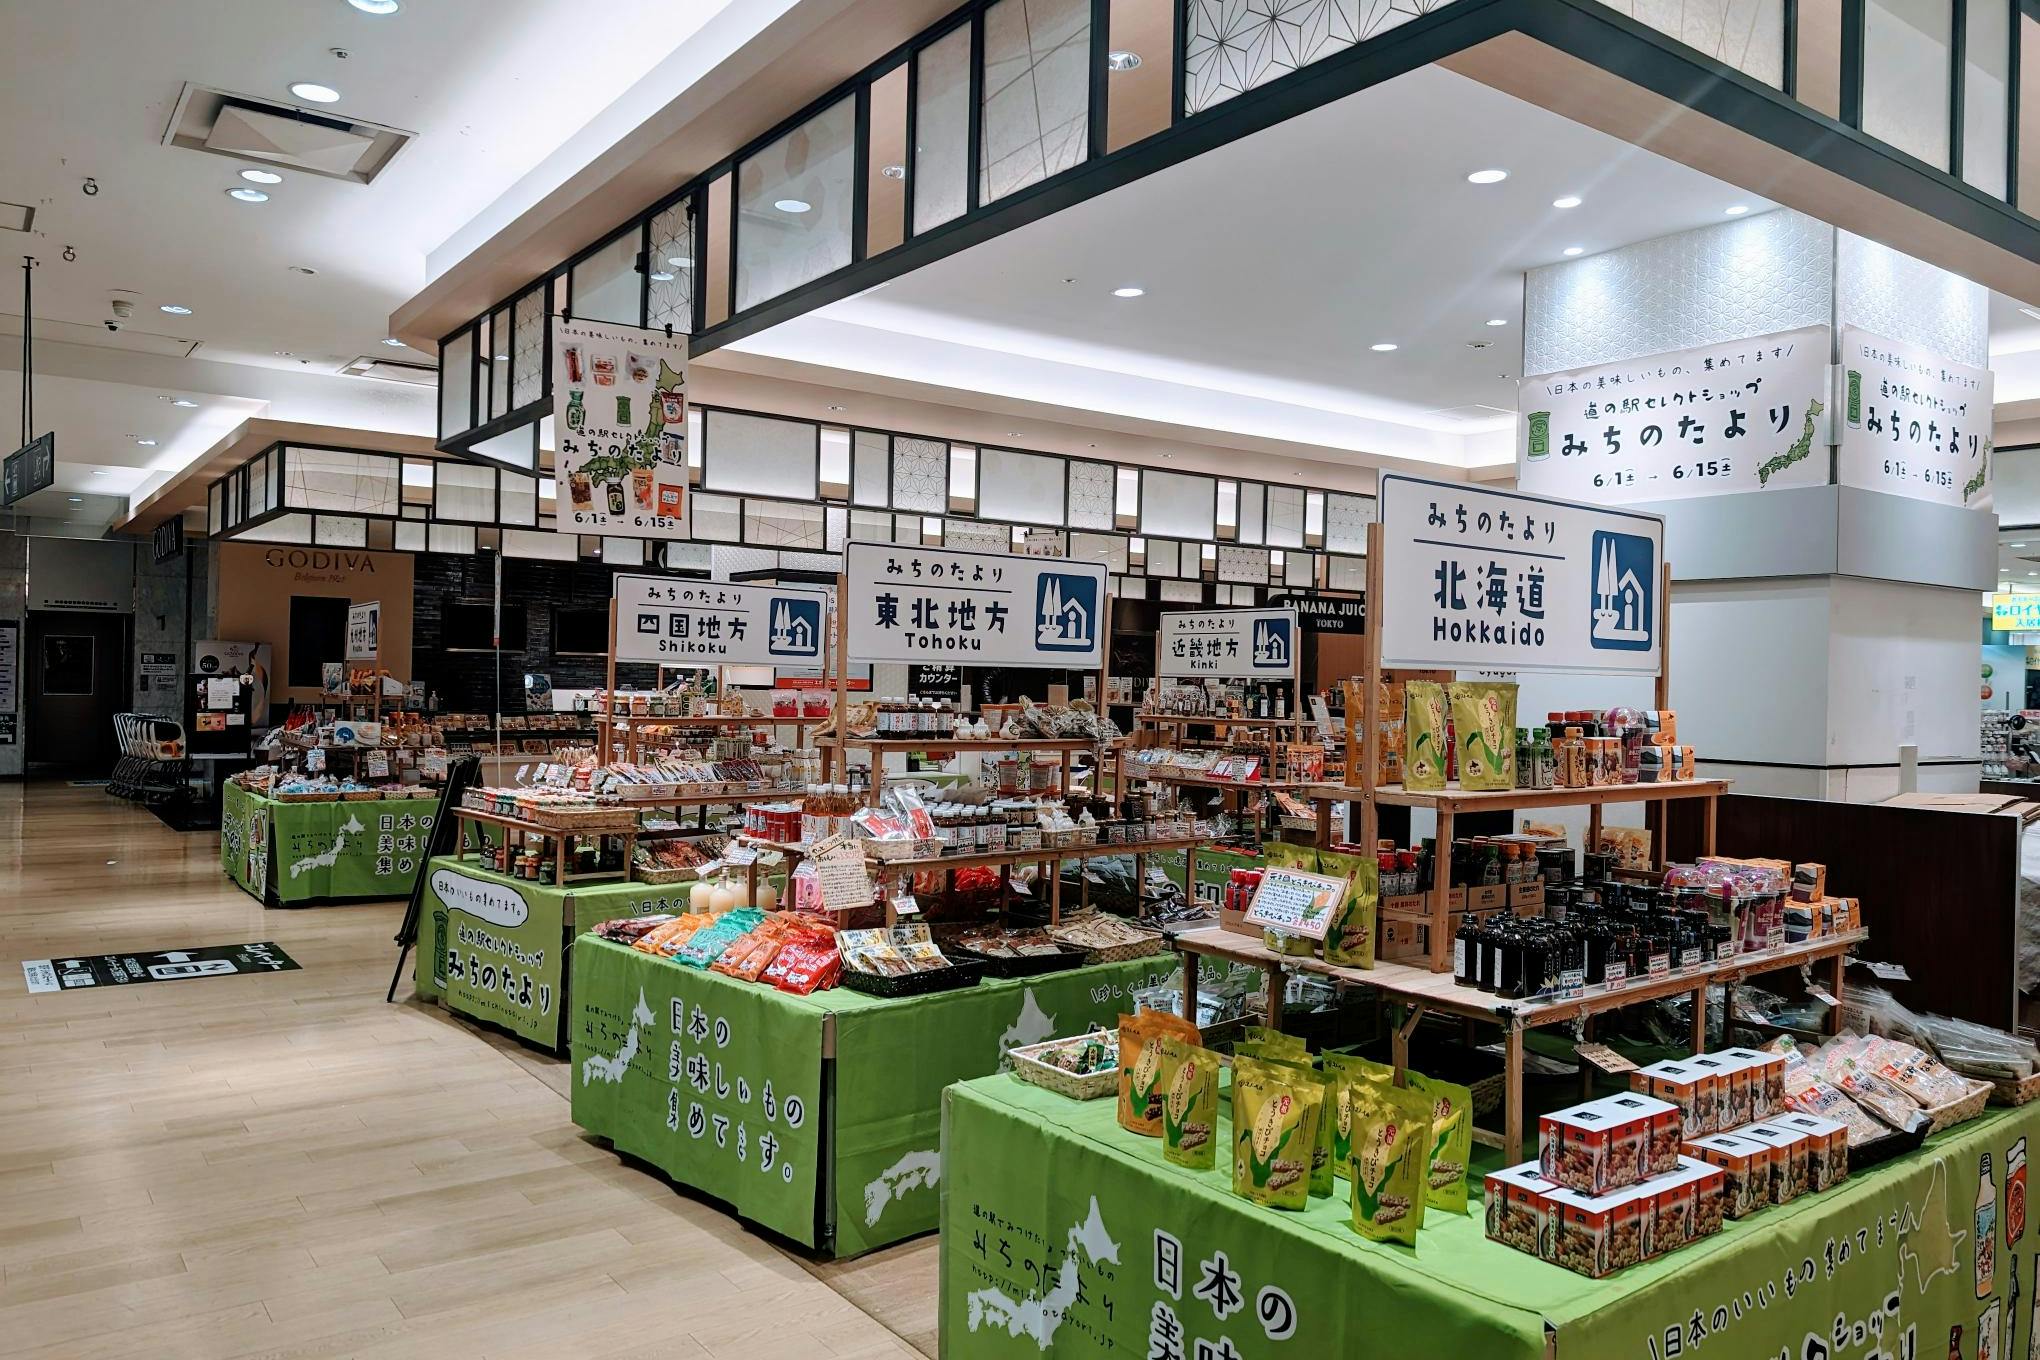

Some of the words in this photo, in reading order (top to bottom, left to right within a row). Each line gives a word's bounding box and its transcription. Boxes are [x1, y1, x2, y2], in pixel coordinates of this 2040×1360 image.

[1583, 378, 1762, 420] 道の駅セレクトショップ
[1879, 377, 1967, 417] 道の駅セレクトショップ
[1561, 405, 1790, 456] みちのたより
[1867, 407, 1978, 458] みちのたより
[563, 440, 682, 464] みちのたより
[1428, 503, 1555, 544] みちのたより
[266, 549, 375, 573] GODIVA
[887, 558, 1002, 583] みちのたより
[648, 587, 741, 605] みちのたより
[1434, 561, 1545, 620] 北海道
[875, 592, 1009, 634] 東北地方
[1284, 599, 1335, 615] BANANA
[638, 613, 747, 642] 四国地方
[1178, 618, 1235, 630] みちのたより
[1316, 619, 1344, 628] TOKYO
[1433, 617, 1545, 647] Hokkaido
[659, 639, 727, 654] Shikoku
[905, 632, 981, 650] Tohoku
[1172, 637, 1239, 658] 近畿地方
[919, 673, 957, 684] カウンター
[1190, 659, 1218, 670] Kinki
[381, 815, 433, 830] 日本の
[459, 924, 543, 967] 道の駅セレクトショップ
[449, 951, 550, 1012] みちのたより
[670, 1001, 729, 1045] 日本の
[671, 1045, 802, 1126] 美味しいもの
[668, 1092, 792, 1179] 集めてます。
[973, 1230, 1114, 1322] みちのたより
[1157, 1234, 1293, 1333] 日本の
